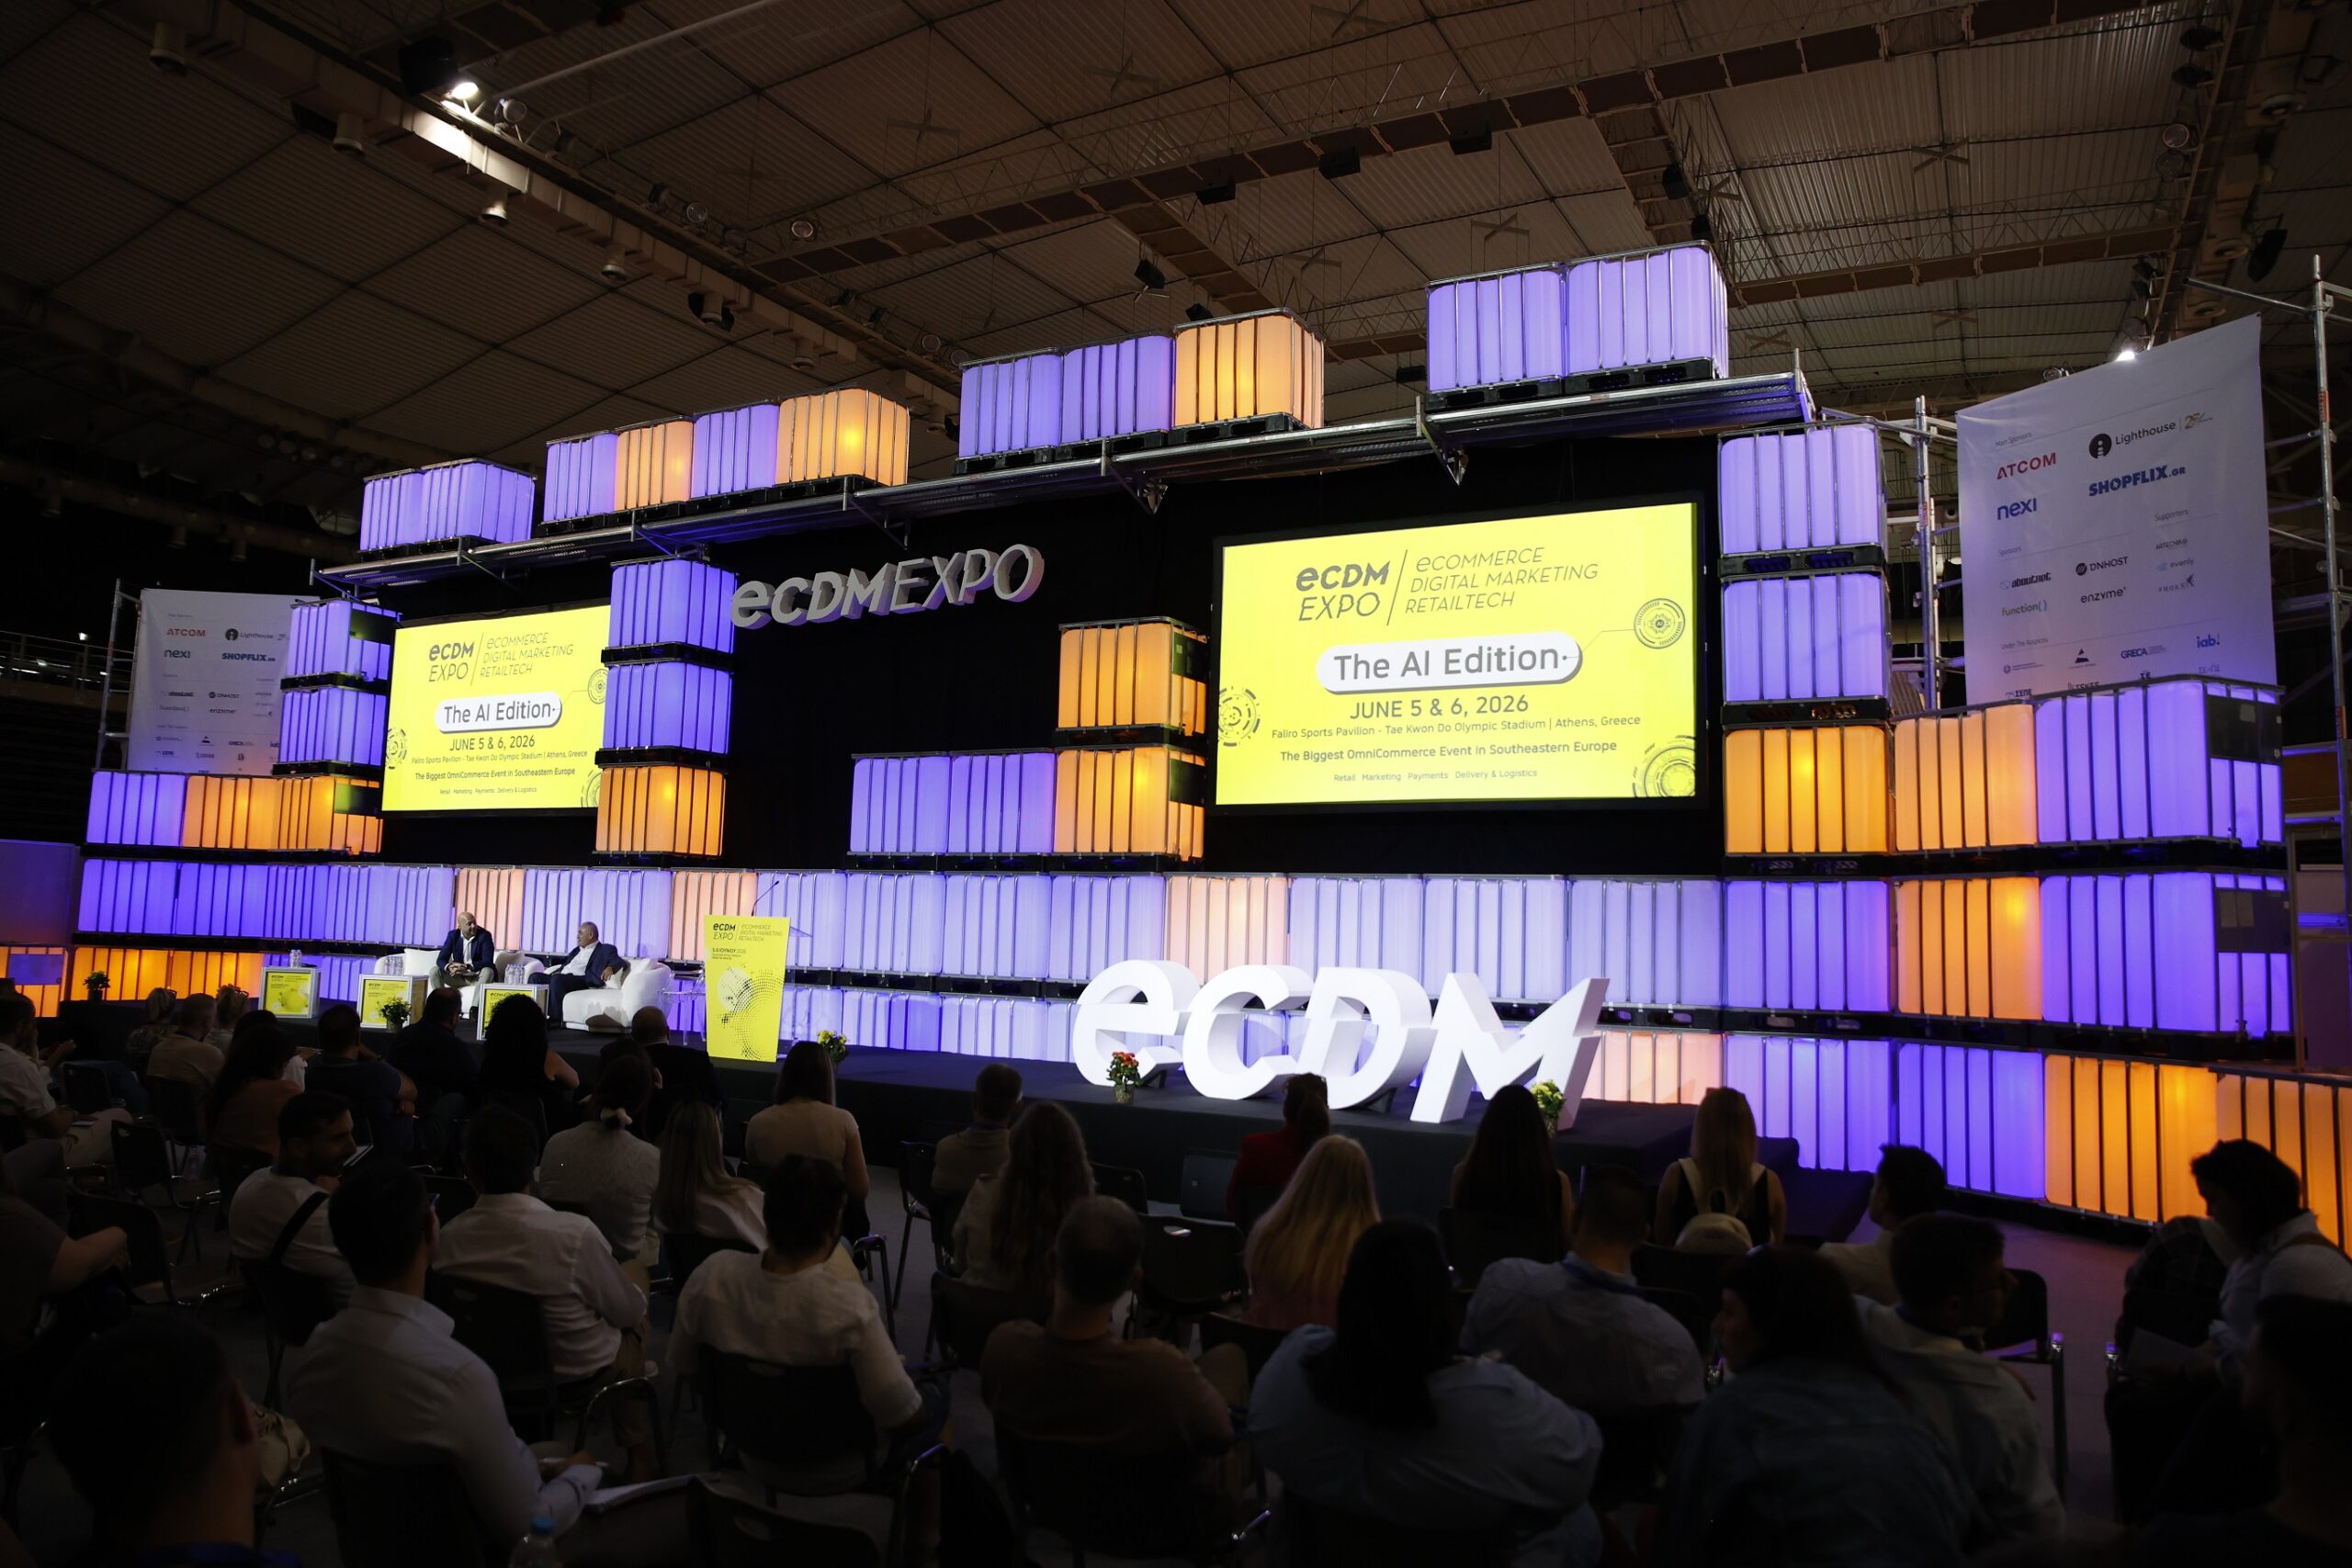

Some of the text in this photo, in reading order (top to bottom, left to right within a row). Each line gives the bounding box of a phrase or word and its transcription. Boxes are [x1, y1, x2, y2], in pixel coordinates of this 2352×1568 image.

[2115, 421, 2176, 446] Lighthouse
[1996, 452, 2056, 479] ATCOM
[2088, 465, 2186, 496] SHOPFLIX.GR
[1996, 498, 2037, 520] nexi
[2154, 508, 2188, 522] Supporters
[1416, 547, 1544, 572] eCOMMERCE
[2089, 556, 2128, 571] DNHOST
[2170, 558, 2195, 568] evenly
[1295, 560, 1390, 592] eCDM
[1410, 563, 1599, 592] DIGITAL MARKETING
[1298, 592, 1381, 621] EXPO
[1405, 592, 1515, 614] RETAILTECH
[167, 628, 206, 637] ATCOM
[486, 632, 548, 649] eCOMMERCE
[164, 649, 190, 659] nexi
[429, 641, 474, 661] eCDM
[483, 644, 573, 663] DIGITAL MARKETING
[2120, 648, 2148, 659] GRECA
[429, 662, 469, 682] EXPO
[480, 663, 533, 678] RETAILTECH
[1334, 653, 1389, 681] The
[1401, 650, 1430, 677] AI
[445, 704, 470, 723] The
[475, 704, 490, 722] AI
[1351, 694, 1529, 718] JUNE 5 & 6, 2026
[1272, 729, 1297, 739] Faliro
[1301, 728, 1332, 739] Sports
[1336, 727, 1374, 736] Pavilion
[1385, 726, 1402, 734] Tae
[1407, 725, 1433, 733] Kwon
[1438, 724, 1451, 732] Do
[1455, 721, 1498, 733] Olympic
[1501, 719, 1545, 729] Stadium
[1555, 718, 1597, 728] Athens,
[1600, 716, 1641, 726] Greece
[450, 735, 535, 750] JUNE 5 & 6, 2026
[1281, 741, 1617, 762] The Biggest OmniCommerce Event in Southeastern Europe
[499, 754, 519, 762] Olympic
[426, 773, 446, 781] Biggest
[447, 771, 490, 779] OmniCommerce
[514, 769, 553, 777] Southeastern
[555, 768, 575, 776] Europe
[1334, 773, 1355, 782] Retail
[1363, 773, 1401, 782] Marketing
[1408, 772, 1448, 780] Payments
[1455, 771, 1488, 779] Delivery
[1499, 769, 1537, 778] Logistics
